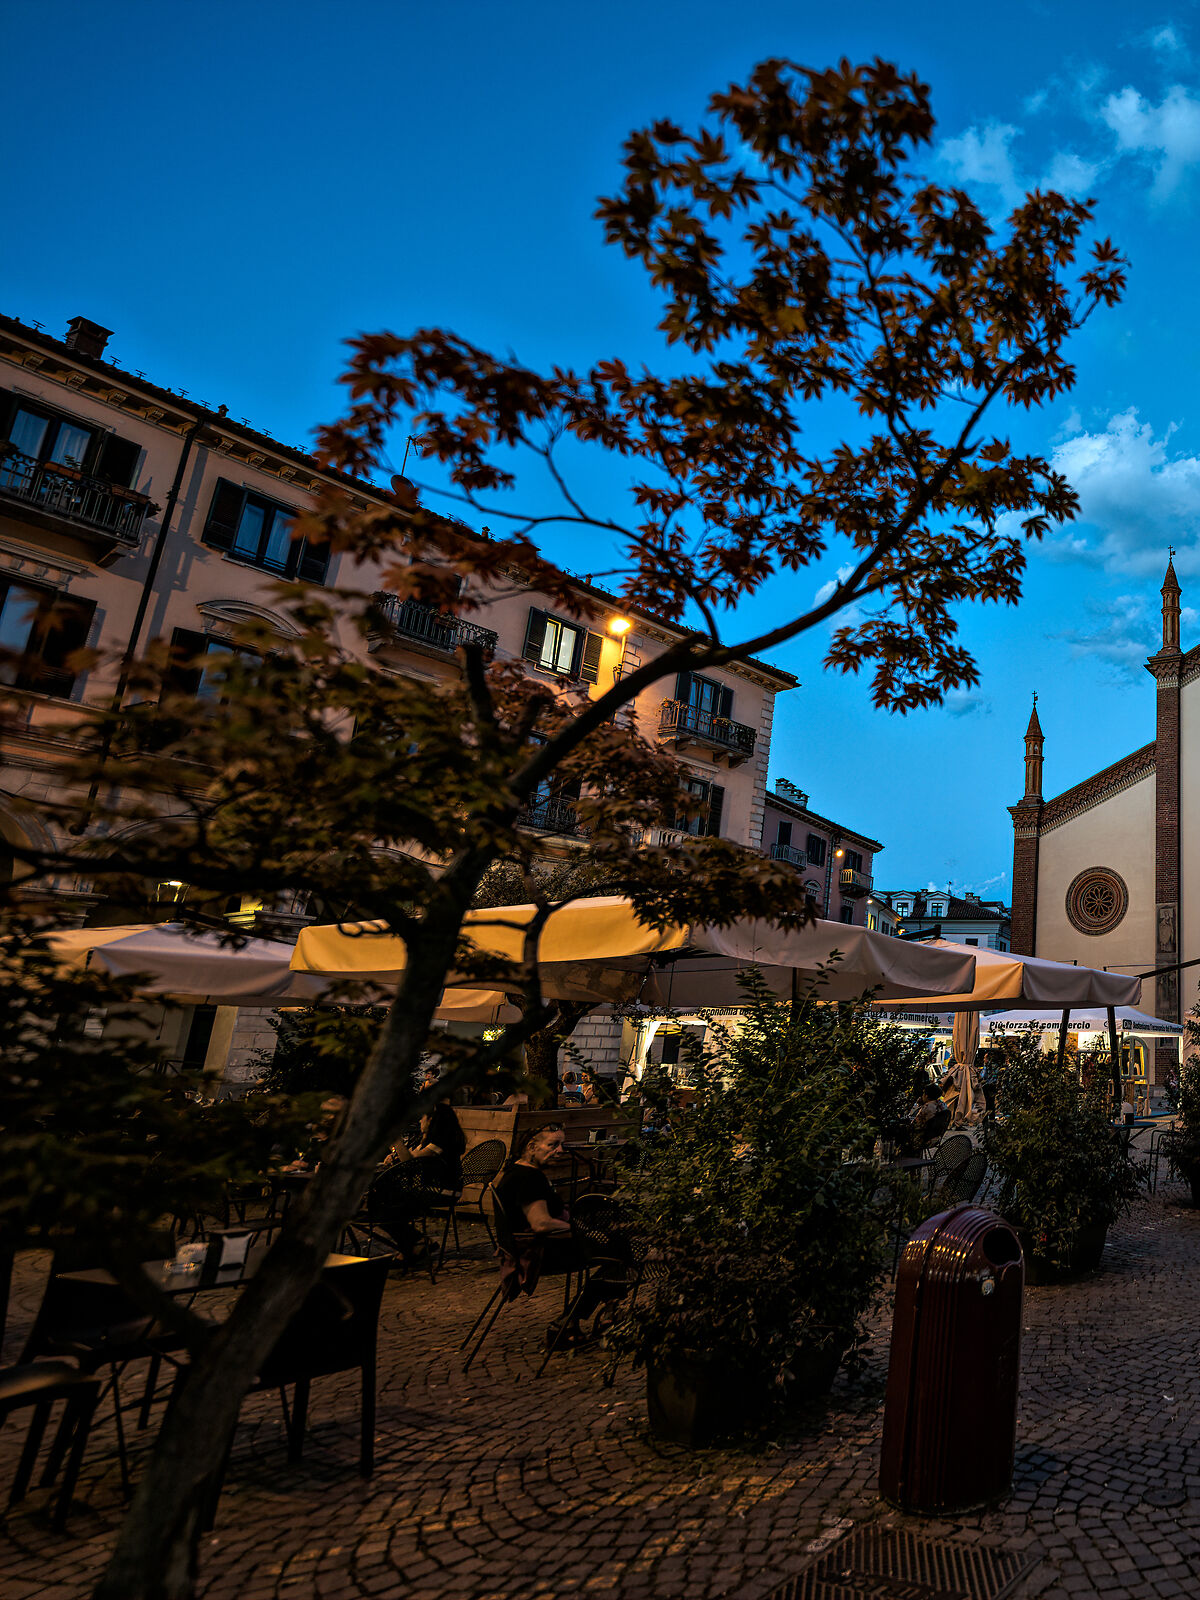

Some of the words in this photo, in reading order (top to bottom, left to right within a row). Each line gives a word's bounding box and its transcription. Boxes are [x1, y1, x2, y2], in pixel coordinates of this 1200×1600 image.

[899, 1013, 939, 1023] commercio
[1005, 1021, 1028, 1029] forza
[1040, 1021, 1091, 1030] comercio
